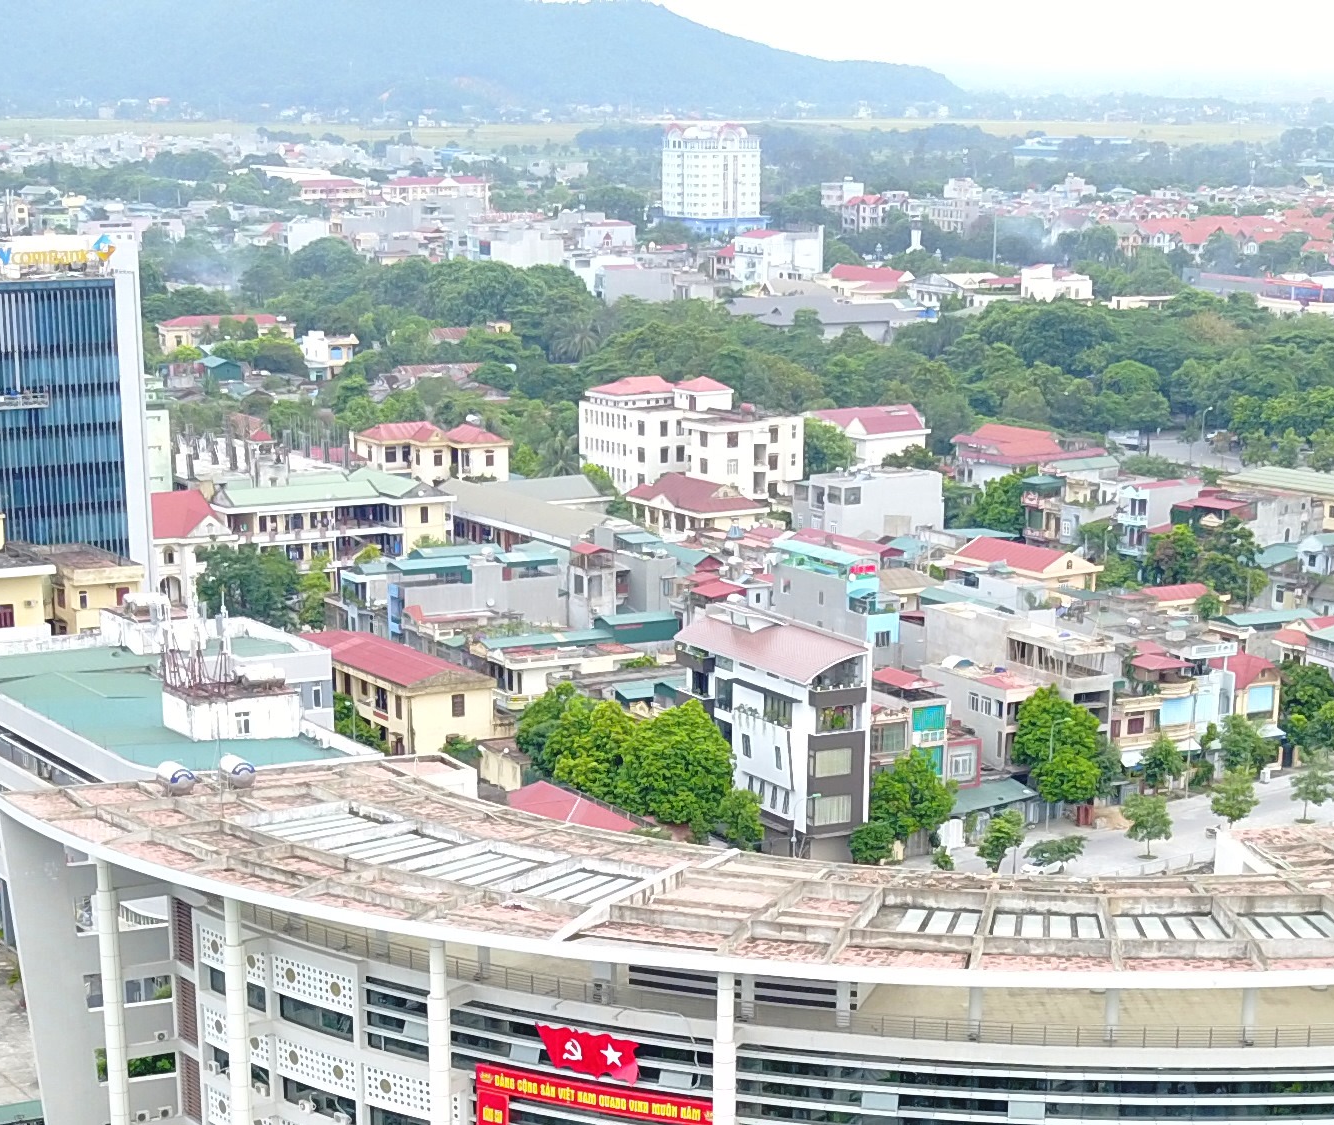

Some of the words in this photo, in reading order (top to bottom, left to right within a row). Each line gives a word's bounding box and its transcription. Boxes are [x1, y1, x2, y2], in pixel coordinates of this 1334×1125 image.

[558, 1085, 575, 1104] VIỆT
[577, 1092, 597, 1106] NAM
[598, 1094, 627, 1111] QUANG
[629, 1098, 649, 1114] VINH
[651, 1102, 678, 1118] MUÔN
[680, 1105, 701, 1121] NĂM
